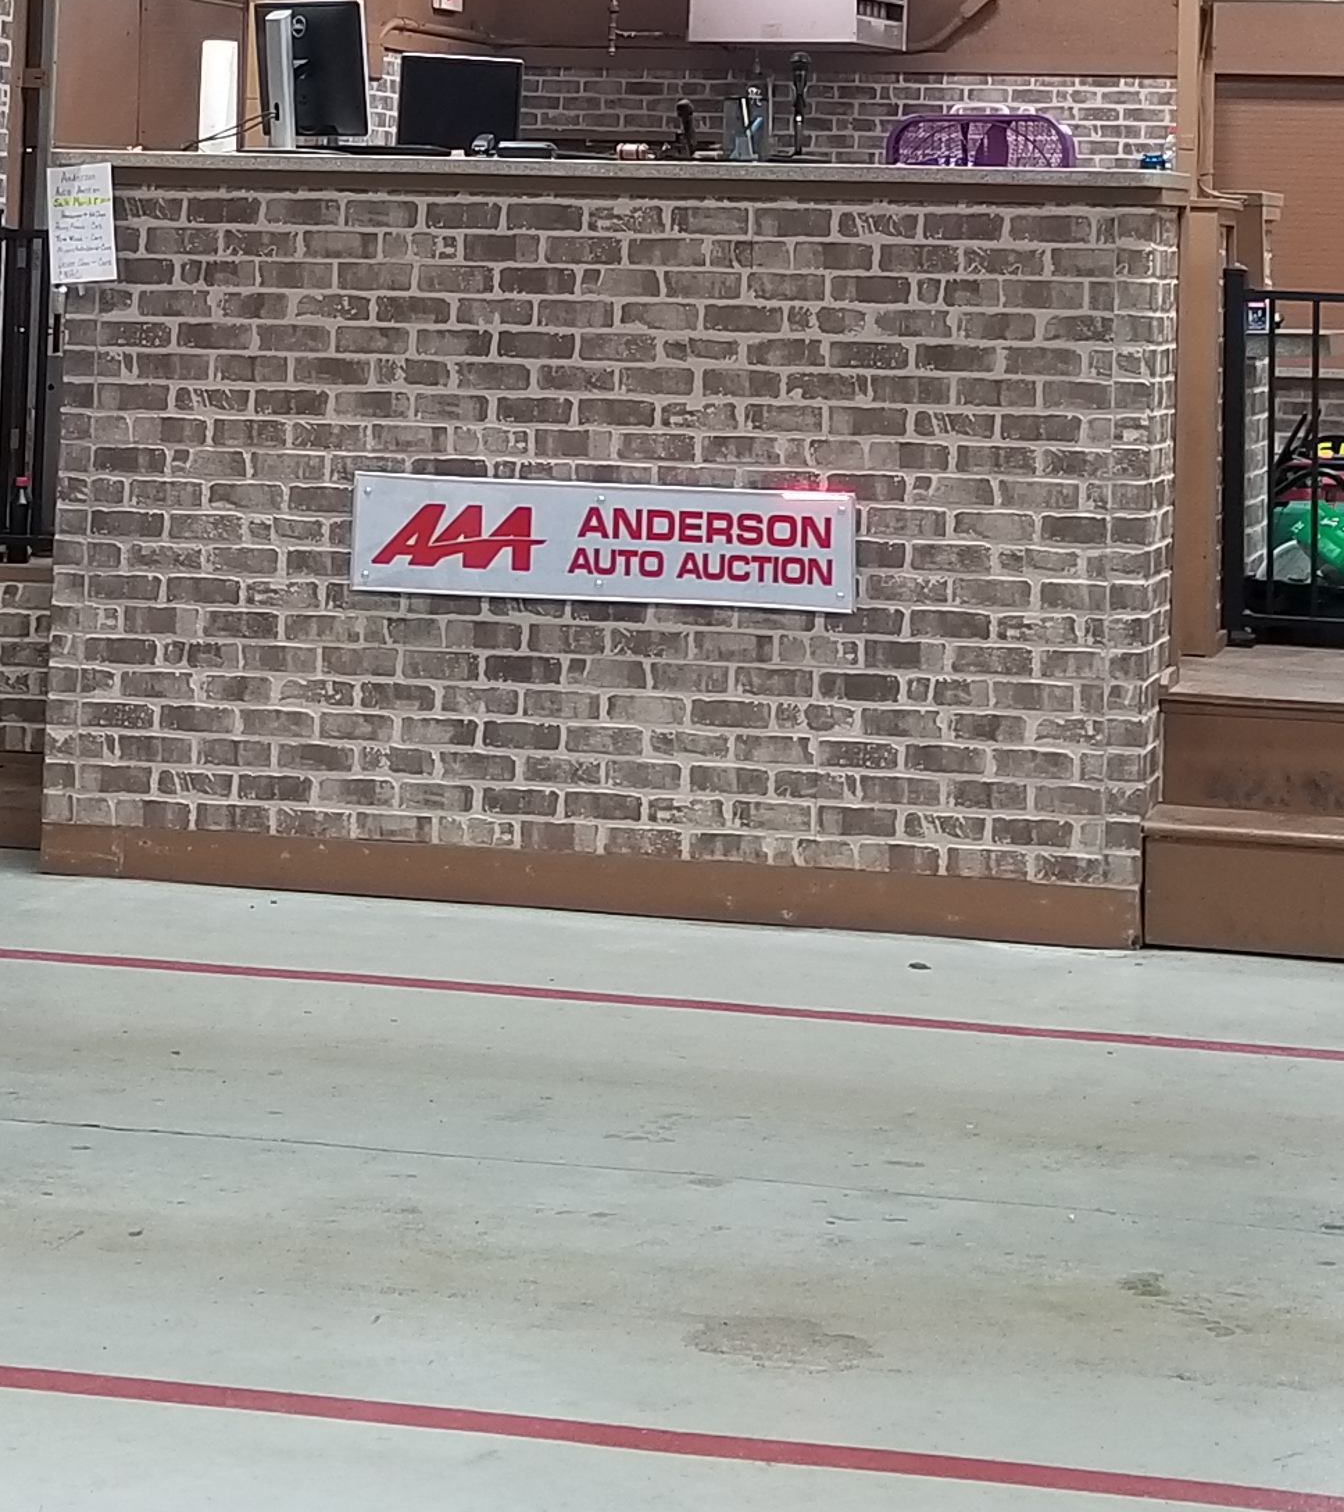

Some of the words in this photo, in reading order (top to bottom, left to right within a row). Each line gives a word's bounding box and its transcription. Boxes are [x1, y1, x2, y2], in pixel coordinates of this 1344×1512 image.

[577, 506, 833, 550] ANDERSON
[567, 547, 665, 578] AUTO
[676, 552, 834, 587] AUCTION
